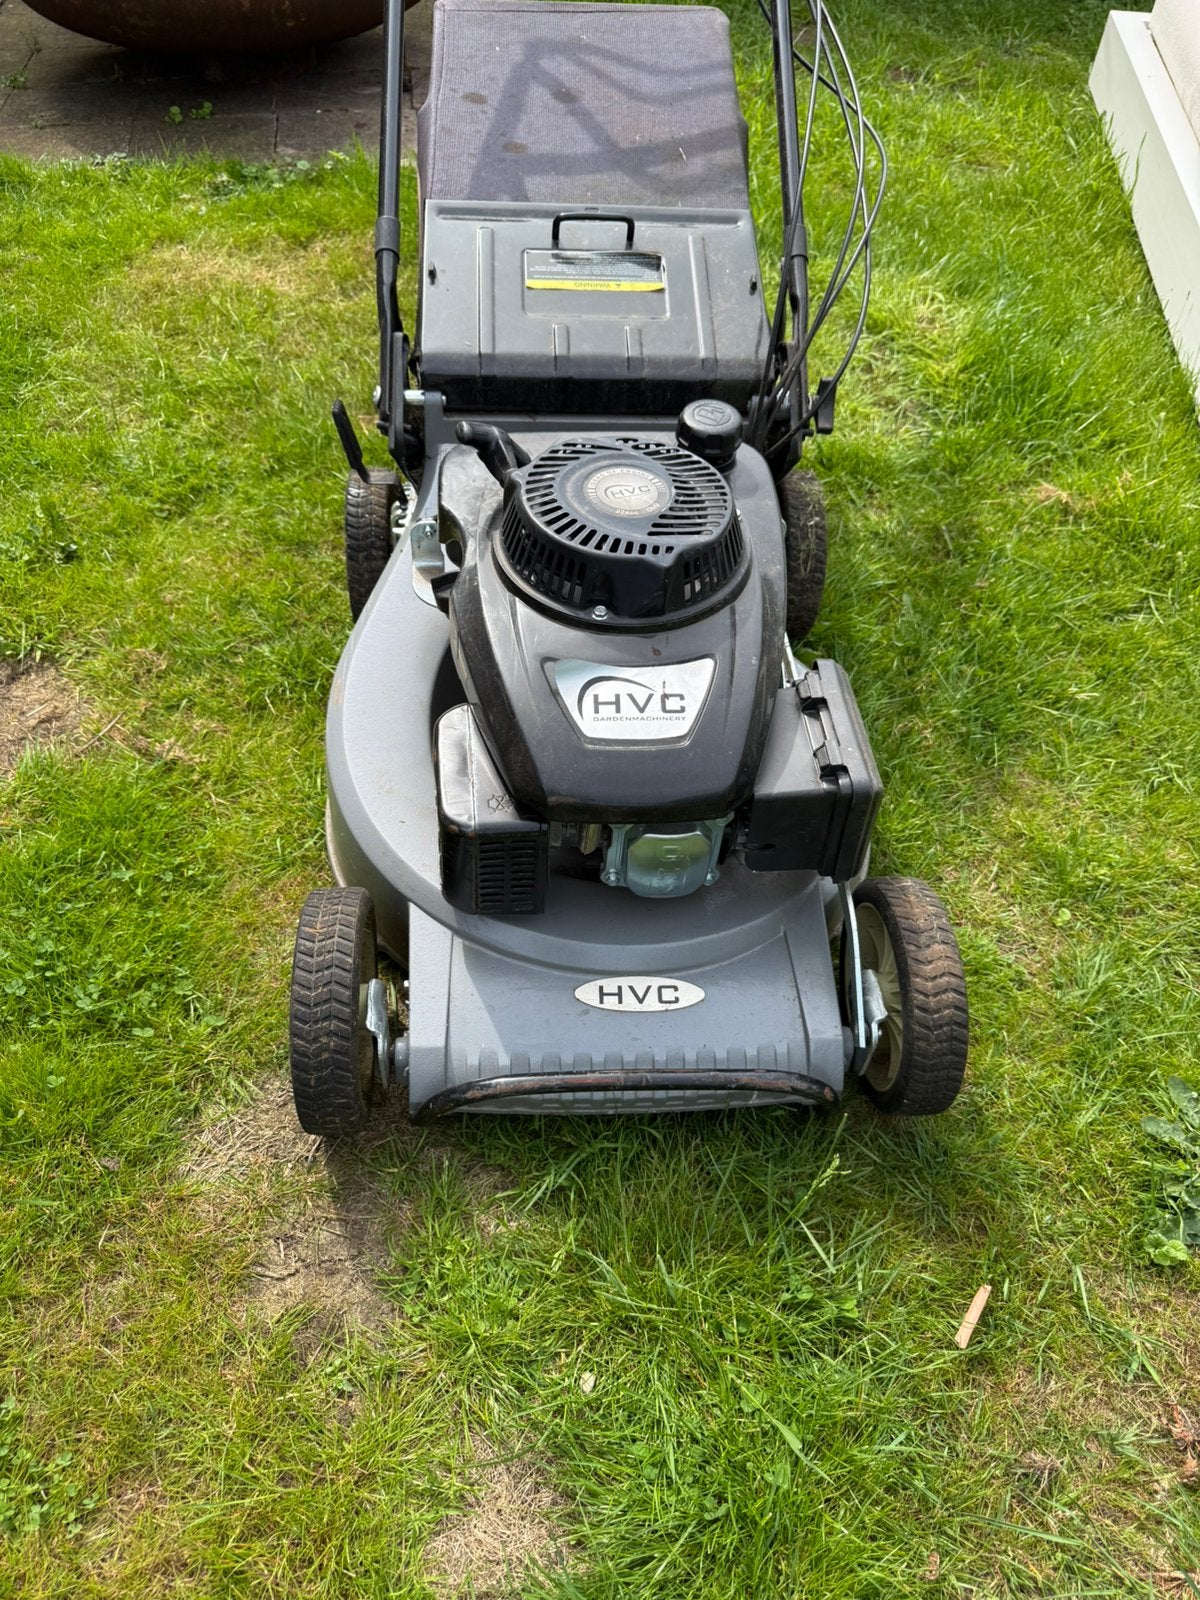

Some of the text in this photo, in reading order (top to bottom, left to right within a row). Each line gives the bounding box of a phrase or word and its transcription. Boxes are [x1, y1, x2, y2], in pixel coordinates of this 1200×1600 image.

[609, 485, 651, 498] HVC
[593, 693, 686, 714] HVC
[598, 985, 680, 1005] HVC
